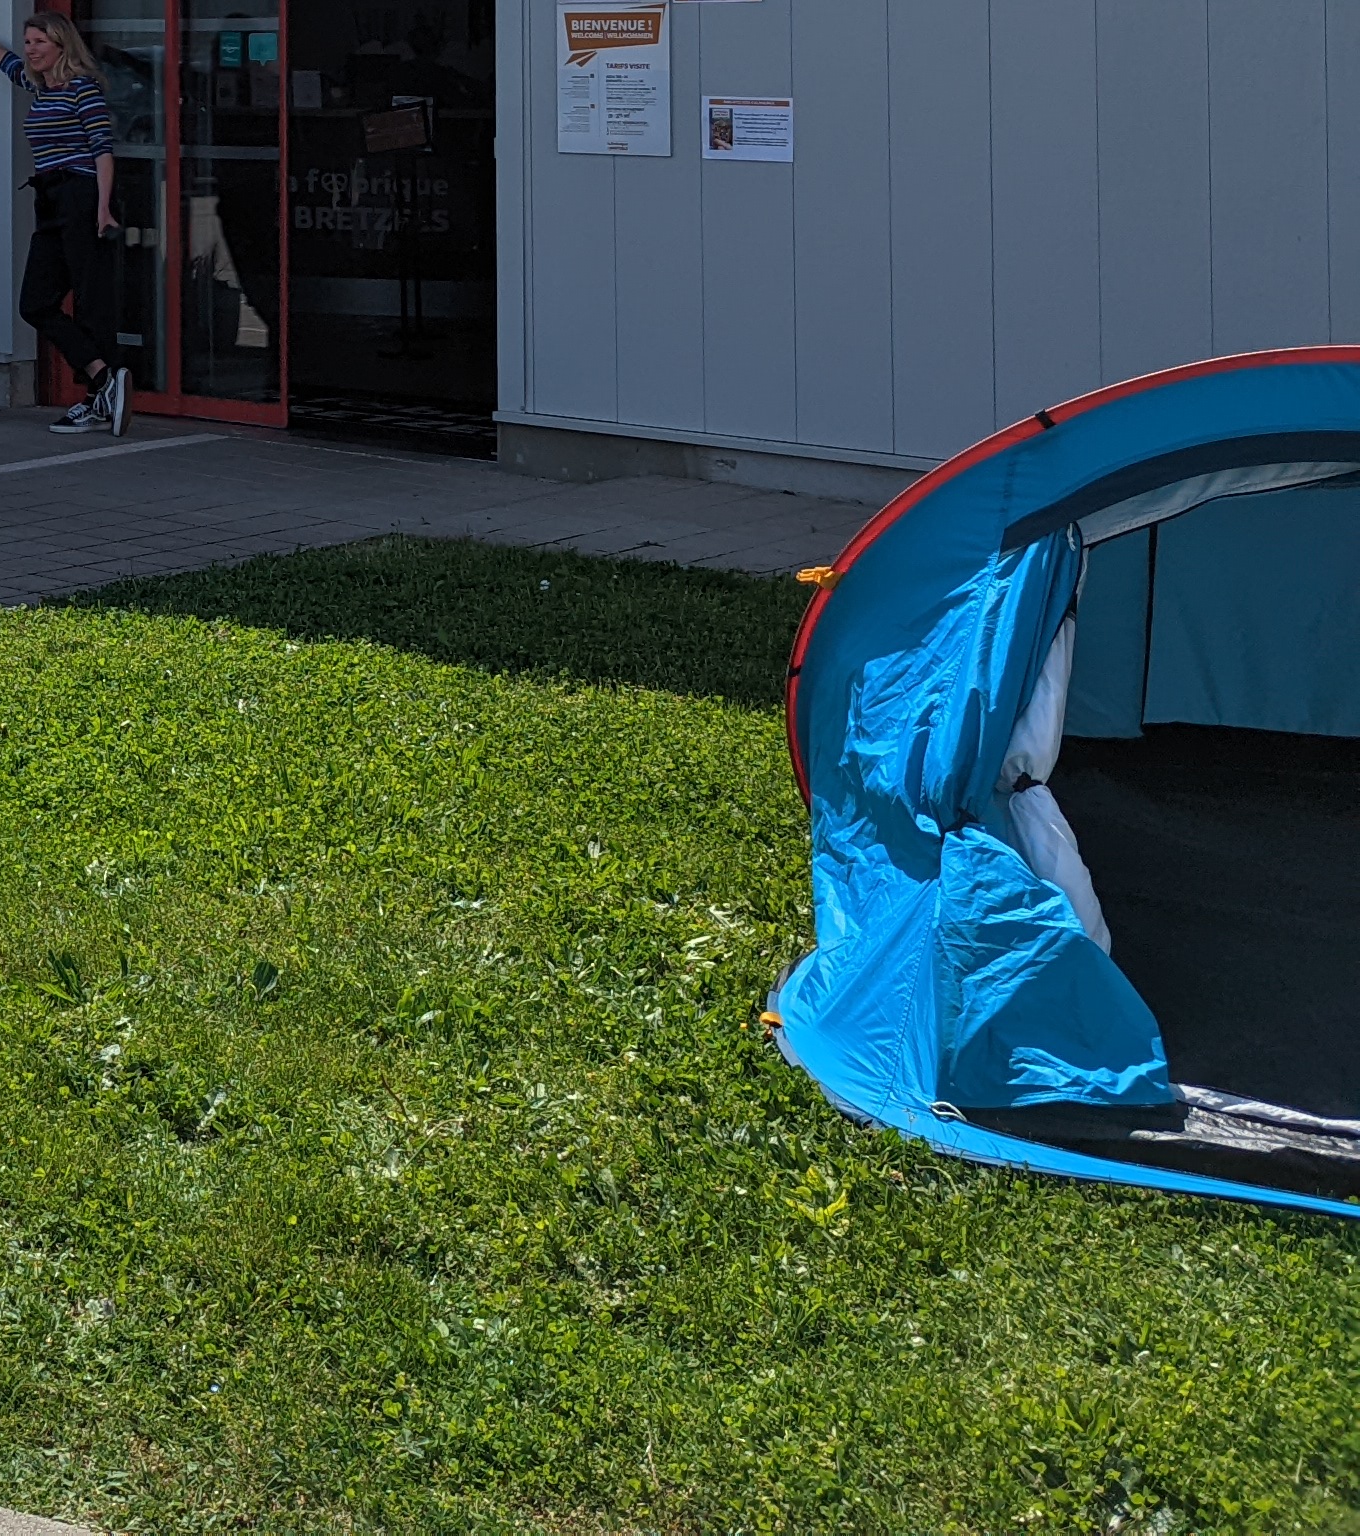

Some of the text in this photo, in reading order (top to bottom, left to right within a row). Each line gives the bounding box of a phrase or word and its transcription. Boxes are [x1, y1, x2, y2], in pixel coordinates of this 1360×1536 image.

[571, 19, 646, 31] BIENVENUE
[629, 62, 651, 70] VISITE
[294, 206, 450, 232] BRETZES
